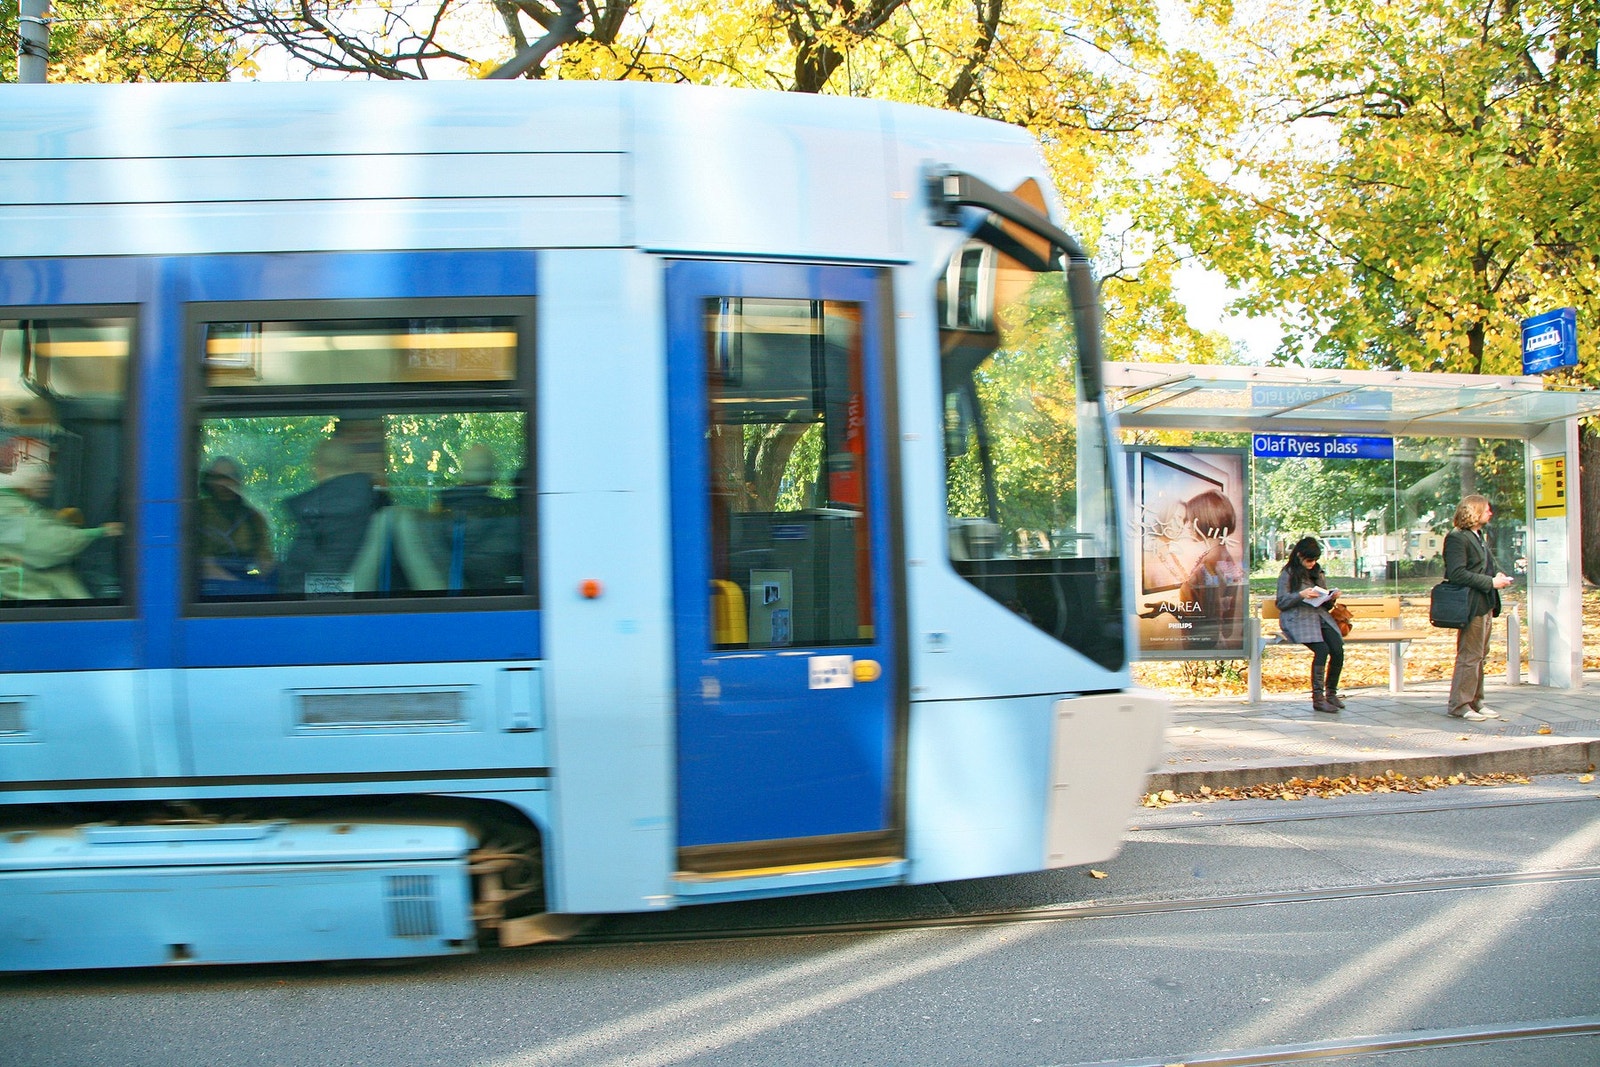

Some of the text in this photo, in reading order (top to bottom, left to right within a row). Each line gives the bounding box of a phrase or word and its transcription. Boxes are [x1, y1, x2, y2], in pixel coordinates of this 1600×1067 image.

[1255, 437, 1358, 457] Olaf Ryes plass
[1159, 601, 1202, 612] AUREA
